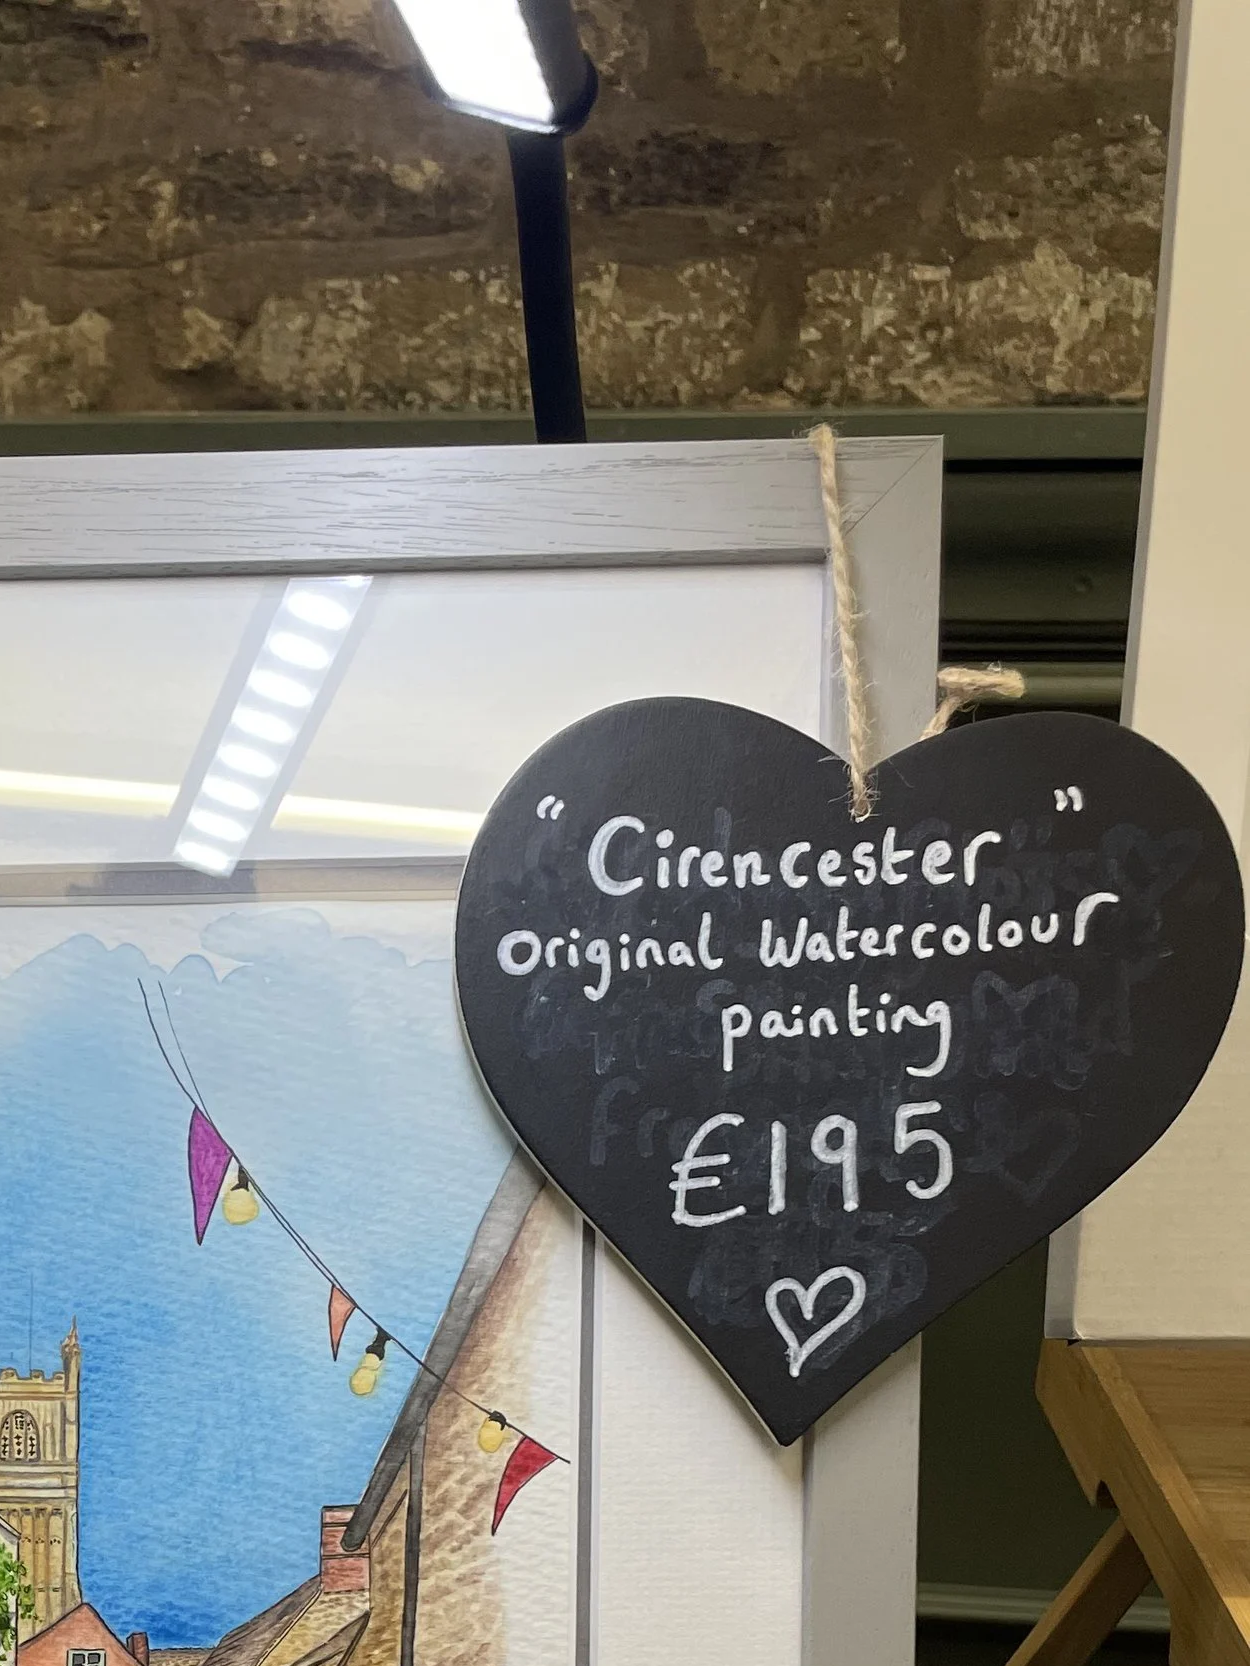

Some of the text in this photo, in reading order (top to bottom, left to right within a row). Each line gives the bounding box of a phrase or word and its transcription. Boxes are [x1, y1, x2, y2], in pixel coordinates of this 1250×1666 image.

[496, 892, 1120, 1002] Original Watercolour
[720, 983, 953, 1078] painting
